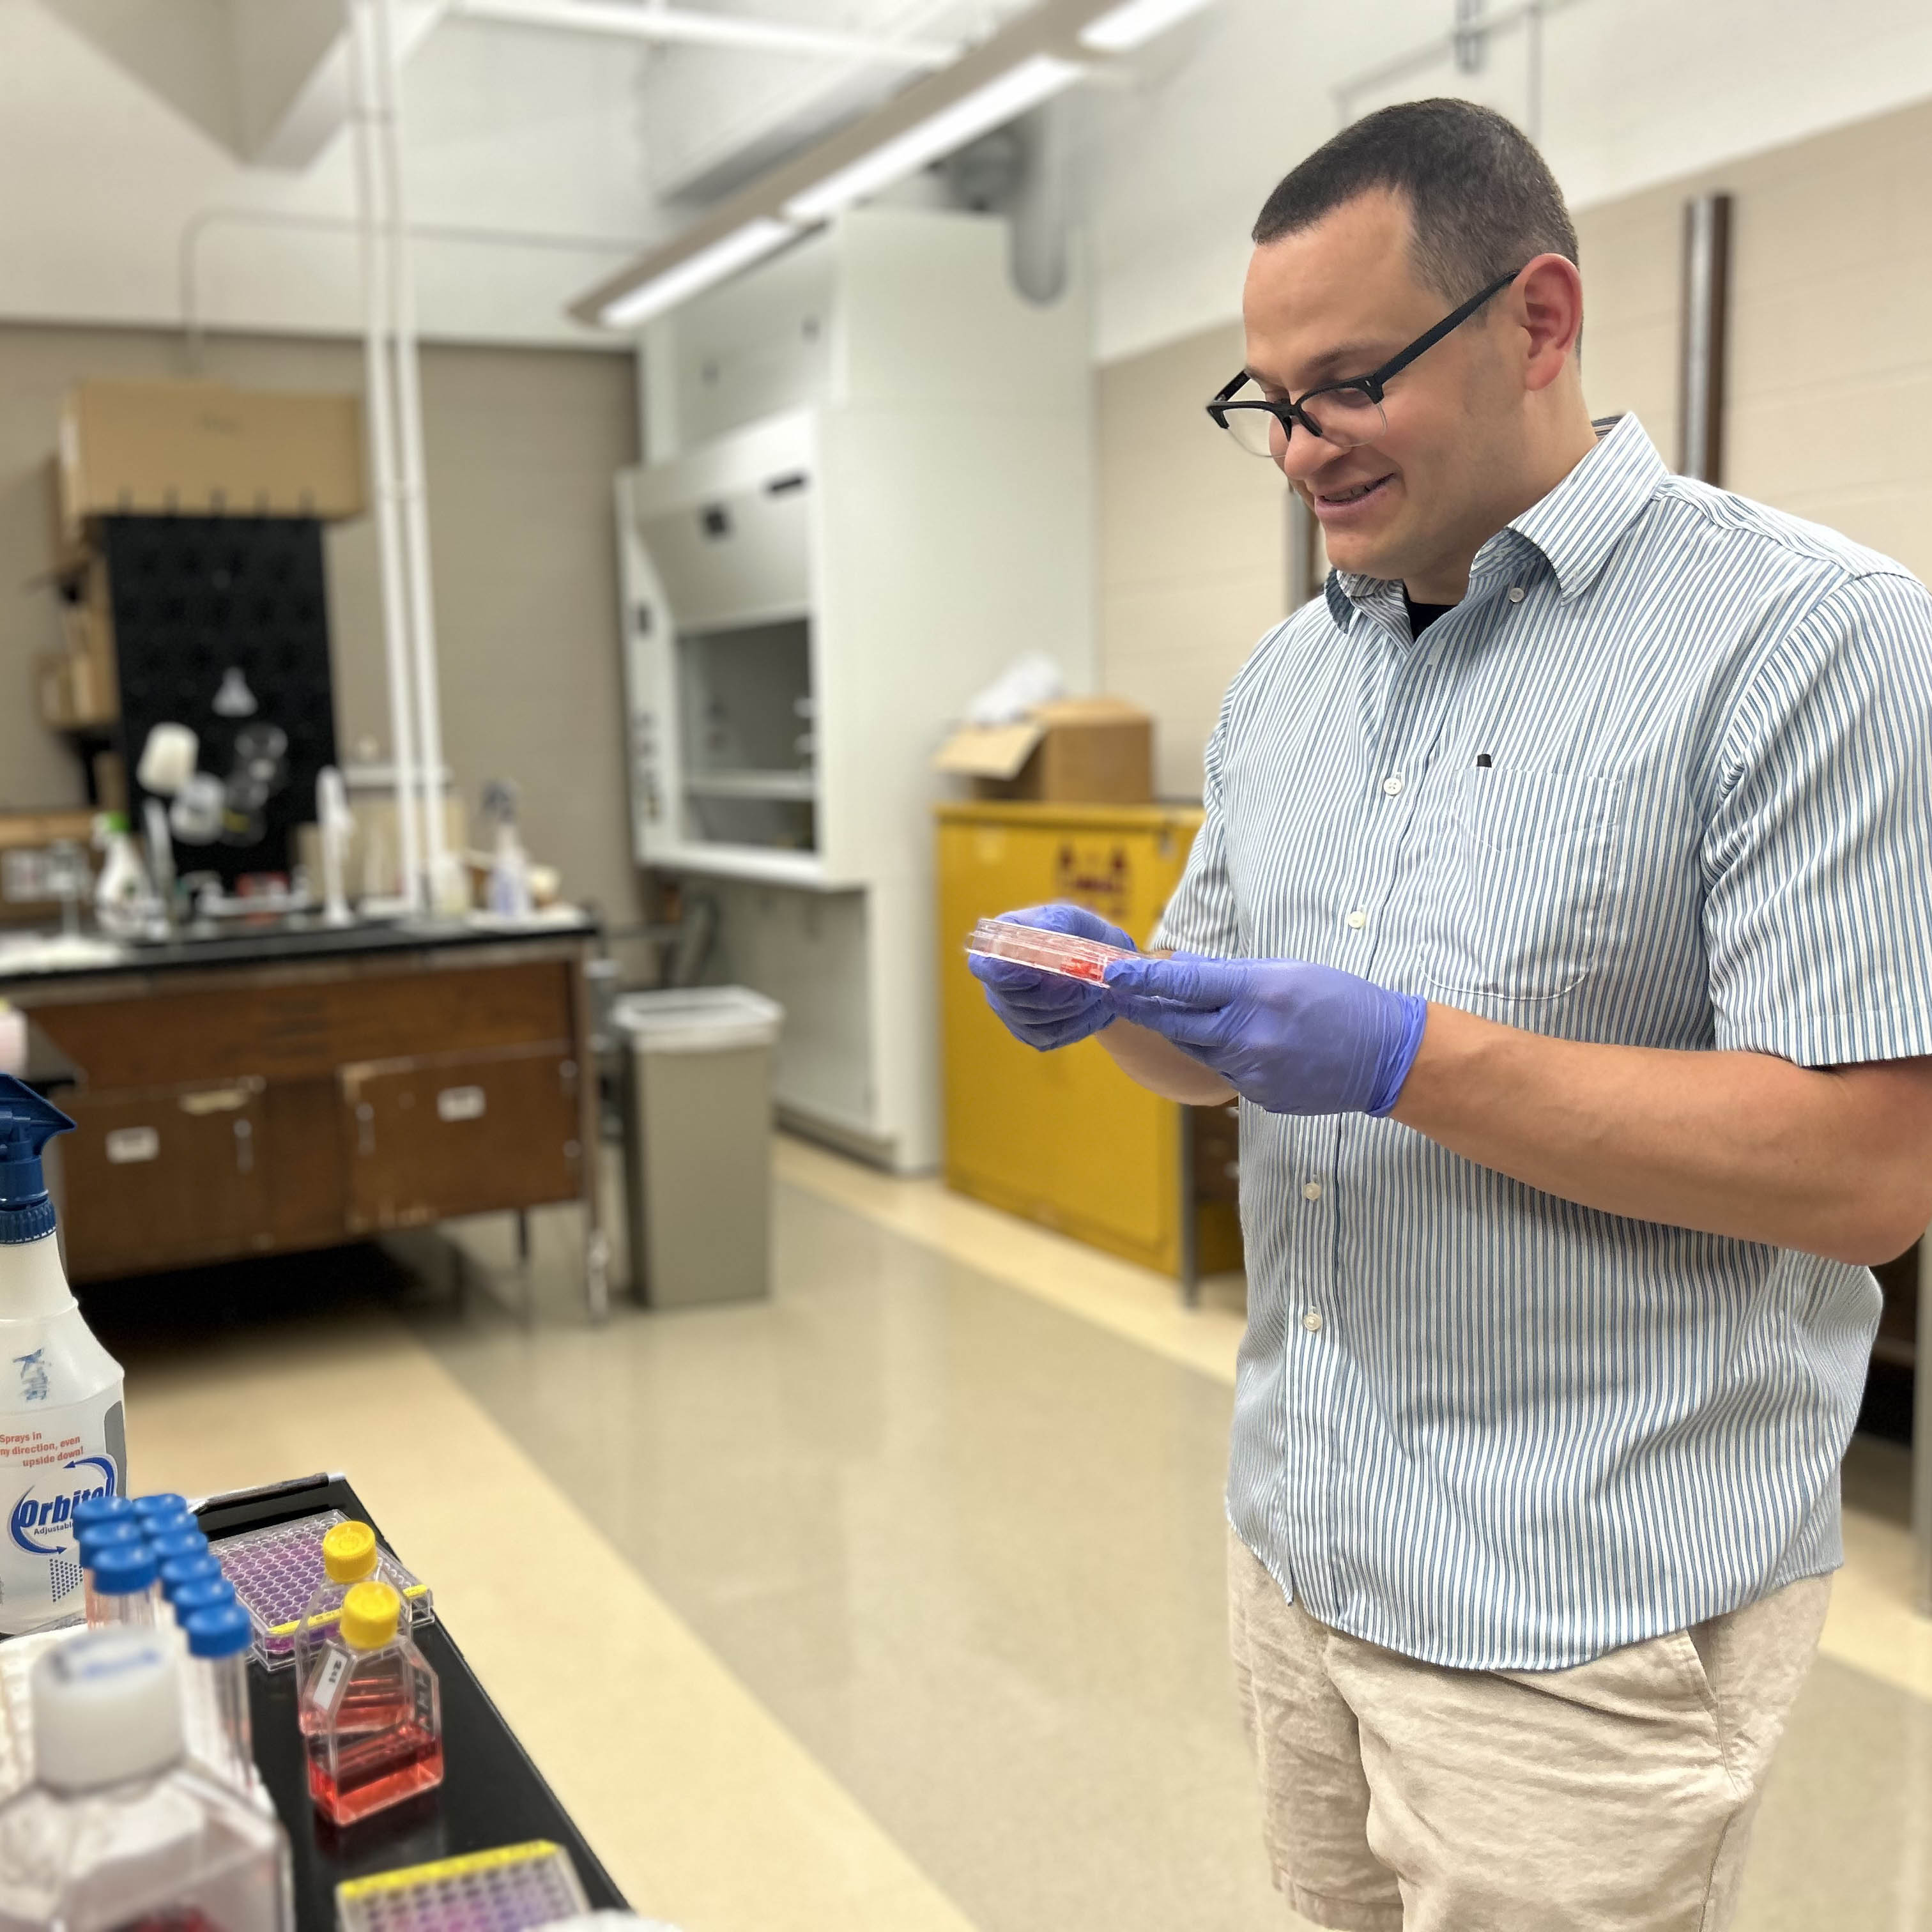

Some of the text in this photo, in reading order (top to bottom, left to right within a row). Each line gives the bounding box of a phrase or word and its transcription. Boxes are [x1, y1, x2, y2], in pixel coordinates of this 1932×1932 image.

[0, 1431, 42, 1445] Sprays in
[0, 1436, 80, 1457] ny direction, even
[23, 1446, 84, 1468] upside down!
[34, 1522, 73, 1535] Adjustabl
